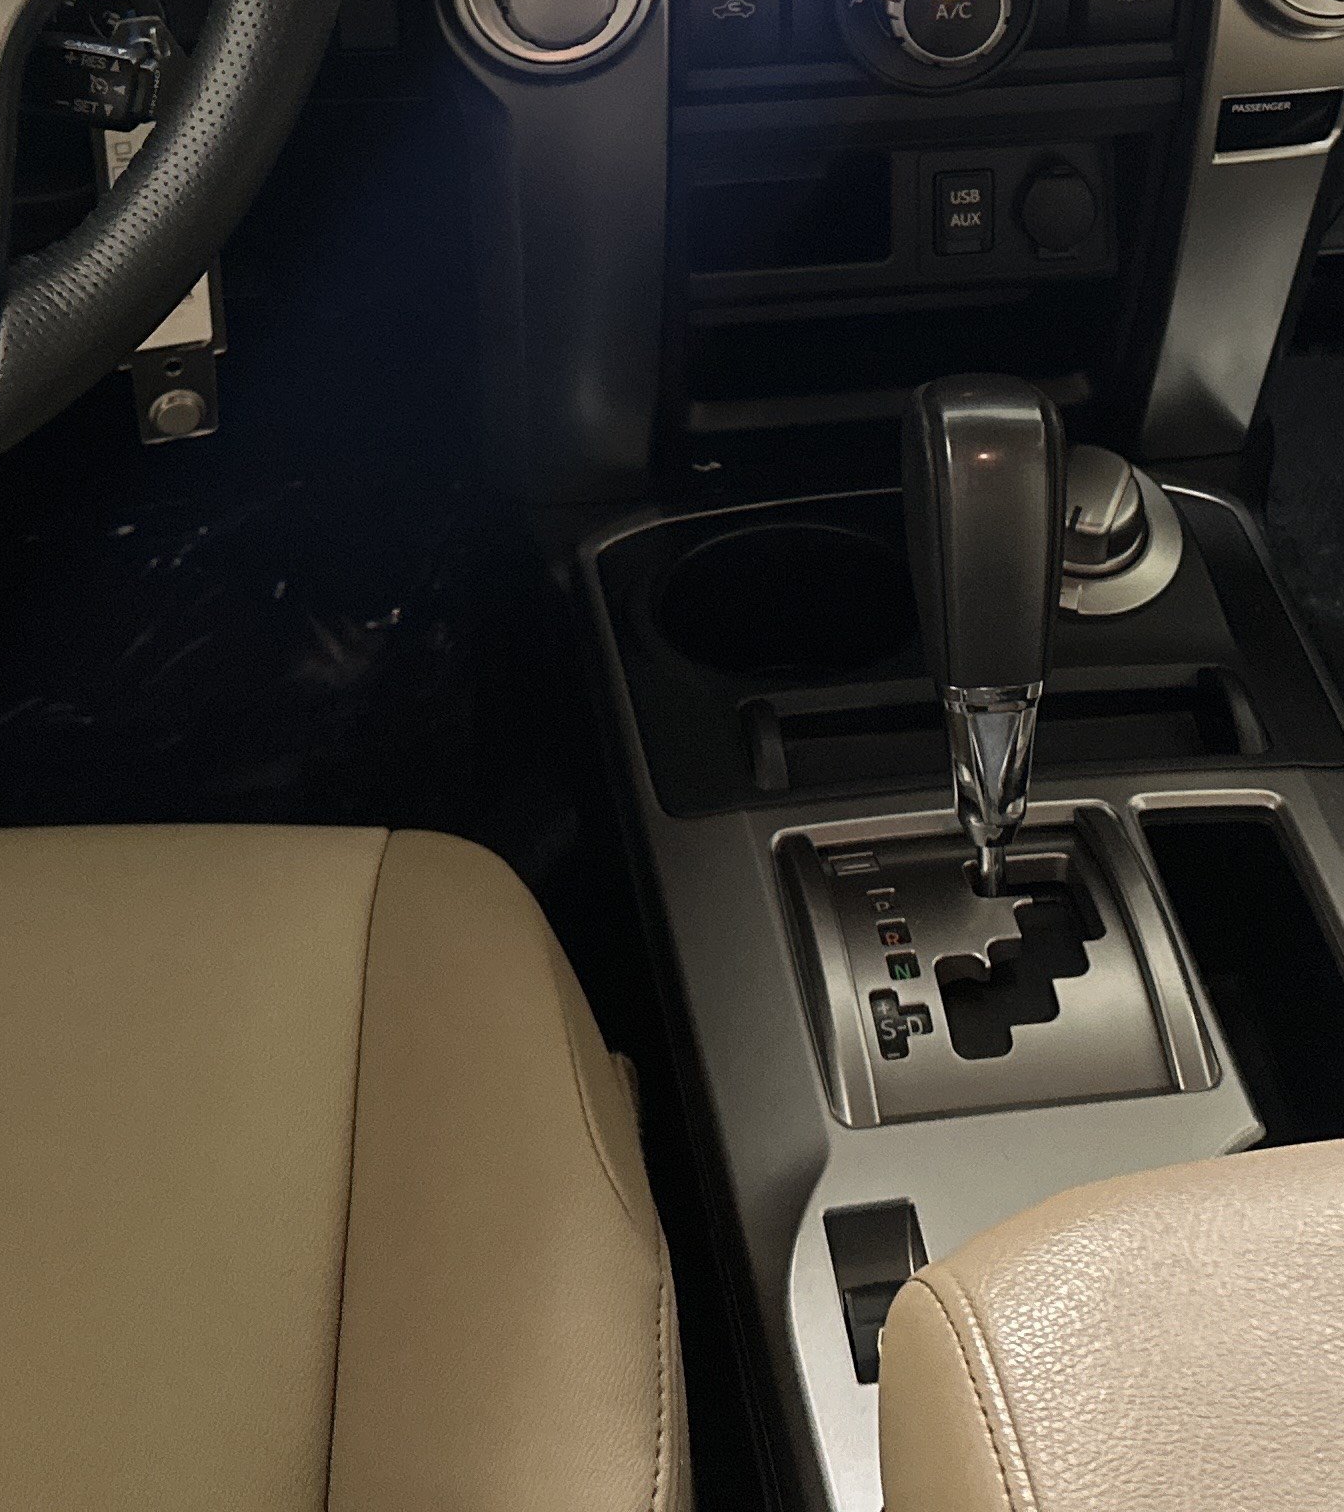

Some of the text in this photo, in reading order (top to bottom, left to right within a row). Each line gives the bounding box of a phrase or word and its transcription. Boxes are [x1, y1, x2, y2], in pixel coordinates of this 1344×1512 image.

[935, 2, 973, 20] A/C
[1232, 101, 1291, 113] PASSENGER
[950, 189, 981, 205] USB
[950, 212, 981, 227] AUX
[885, 932, 899, 947] R
[894, 963, 912, 980] N
